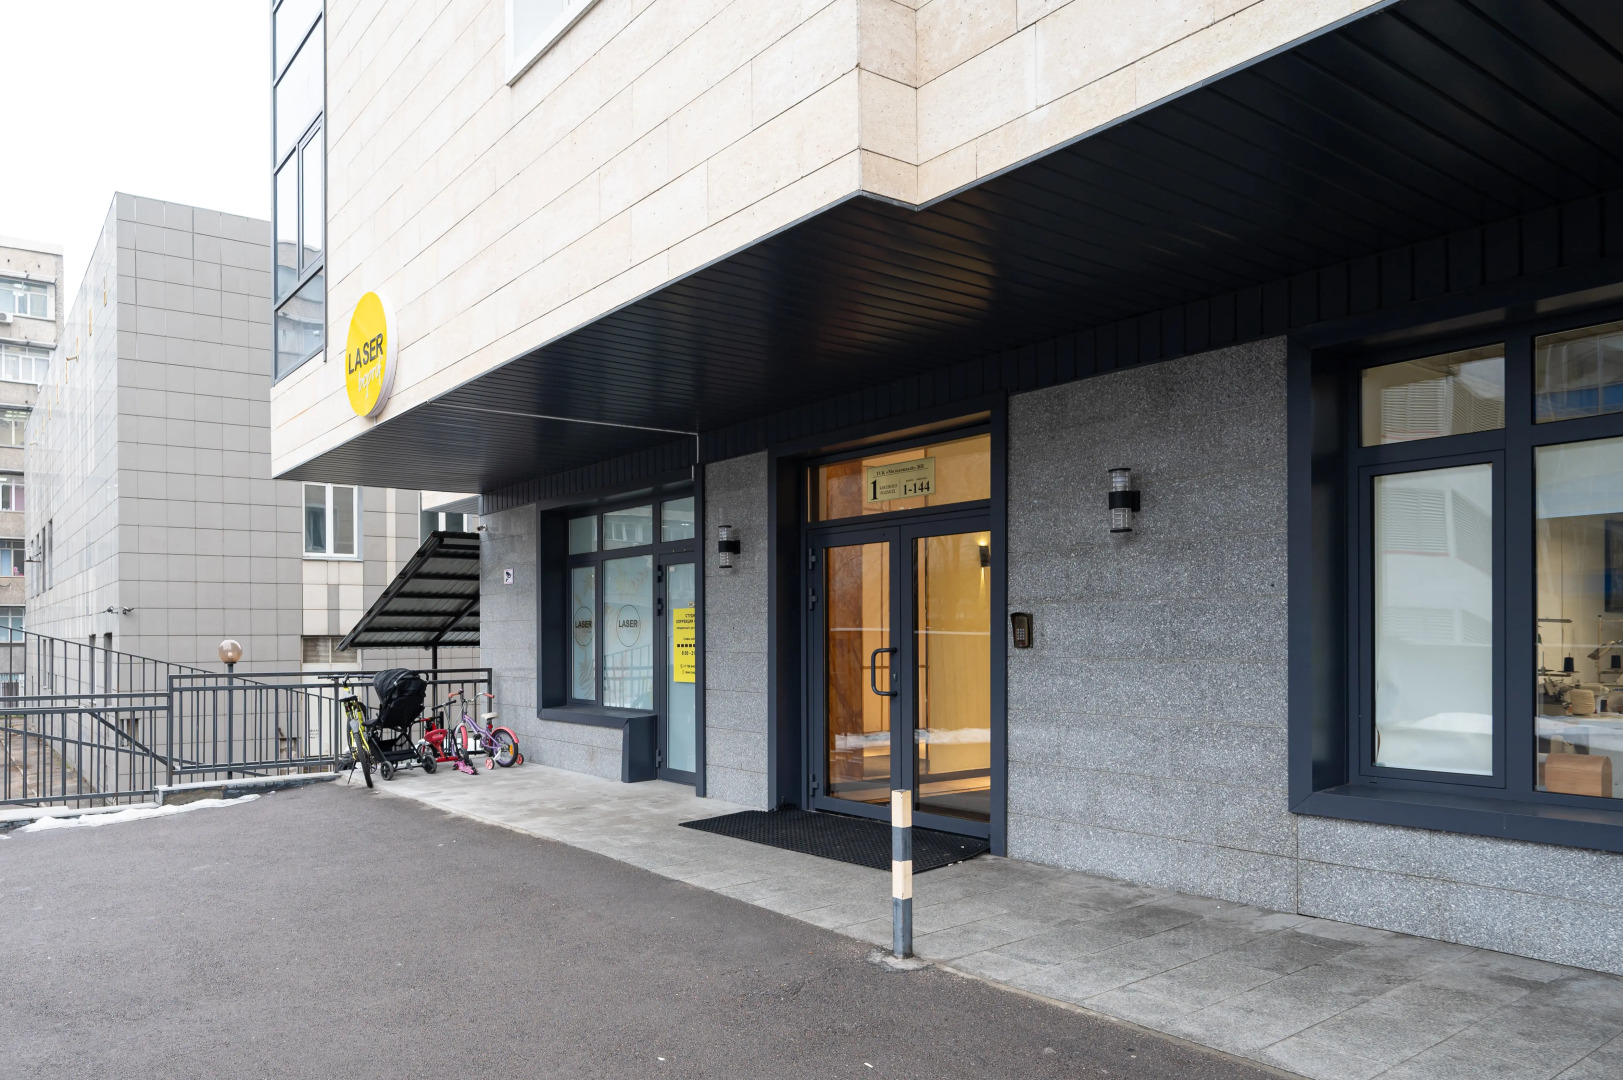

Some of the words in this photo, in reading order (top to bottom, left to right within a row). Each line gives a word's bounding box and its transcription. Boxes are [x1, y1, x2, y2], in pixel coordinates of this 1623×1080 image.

[348, 333, 383, 375] LASER
[870, 479, 879, 500] 1
[903, 480, 930, 495] 1-144
[575, 620, 592, 628] LASER
[618, 619, 638, 628] LASER
